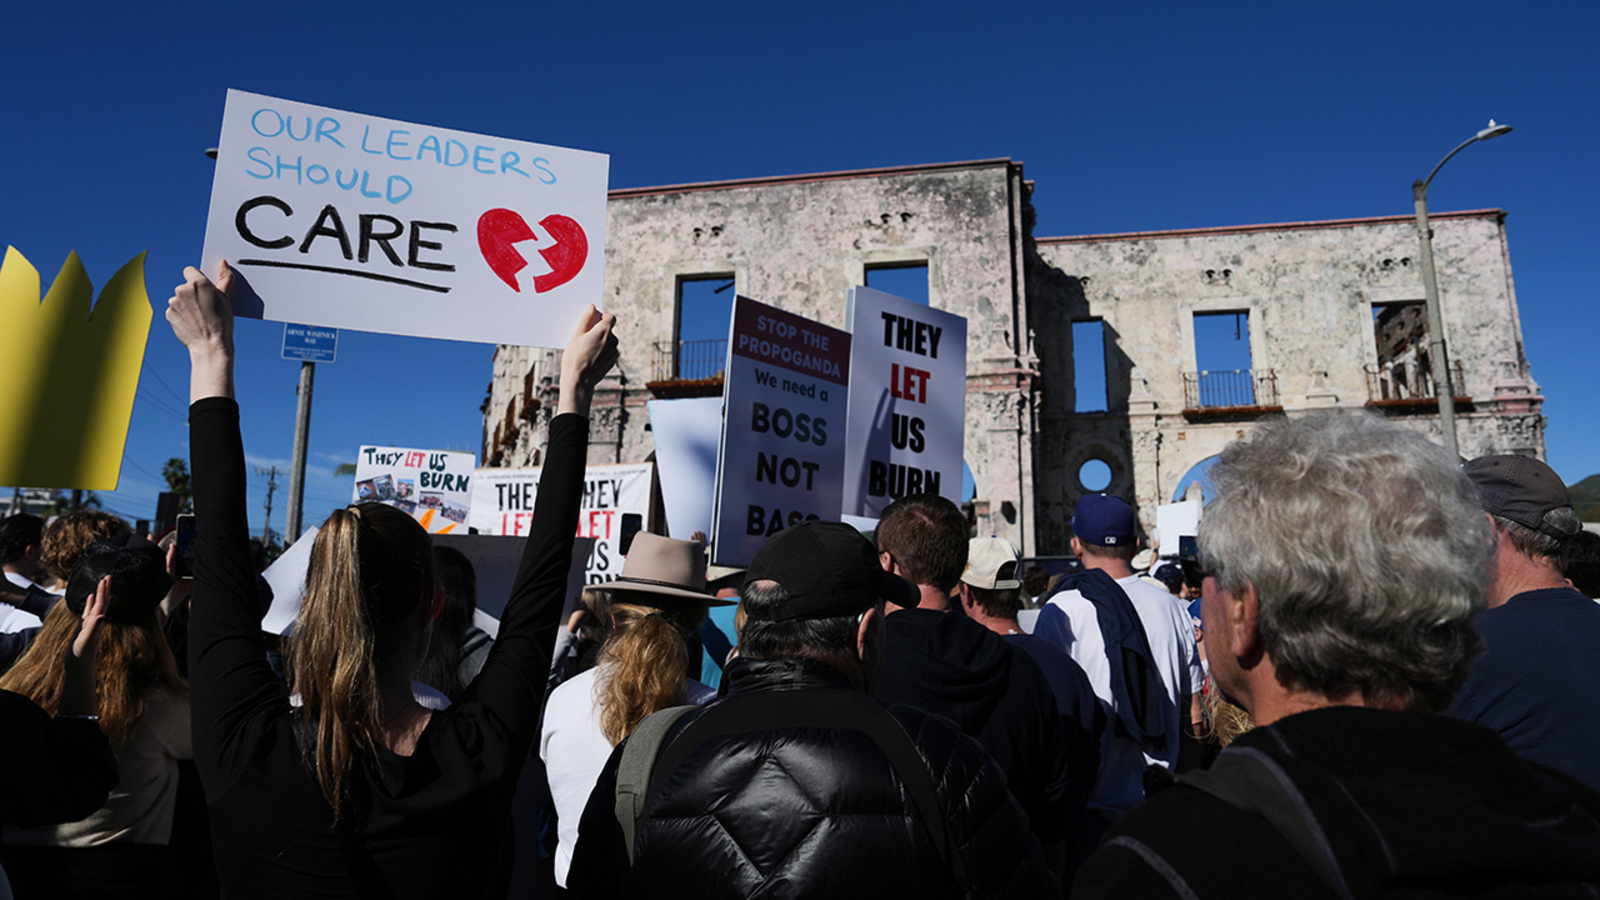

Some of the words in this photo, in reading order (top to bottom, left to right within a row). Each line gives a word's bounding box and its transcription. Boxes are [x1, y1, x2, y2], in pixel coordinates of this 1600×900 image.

[250, 108, 345, 148] OUR
[361, 124, 557, 185] LEADERS
[245, 147, 413, 204] SHOULD
[235, 195, 458, 273] CARE
[756, 315, 797, 340] STOP
[802, 329, 829, 351] THE
[881, 311, 942, 359] THEY
[739, 334, 841, 378] PROPOGANDA
[754, 368, 778, 389] We
[782, 379, 816, 399] need
[820, 389, 829, 402] a
[890, 362, 930, 404] LET
[751, 402, 828, 446] BOSS
[891, 412, 925, 453] US
[363, 447, 404, 466] THEY
[404, 451, 426, 468] LET
[429, 453, 448, 471] US
[756, 452, 819, 491] NOT
[420, 471, 470, 492] BURN
[495, 482, 539, 511] THE
[583, 479, 623, 509] HEY
[869, 460, 940, 500] BURN
[746, 504, 821, 538] BAS
